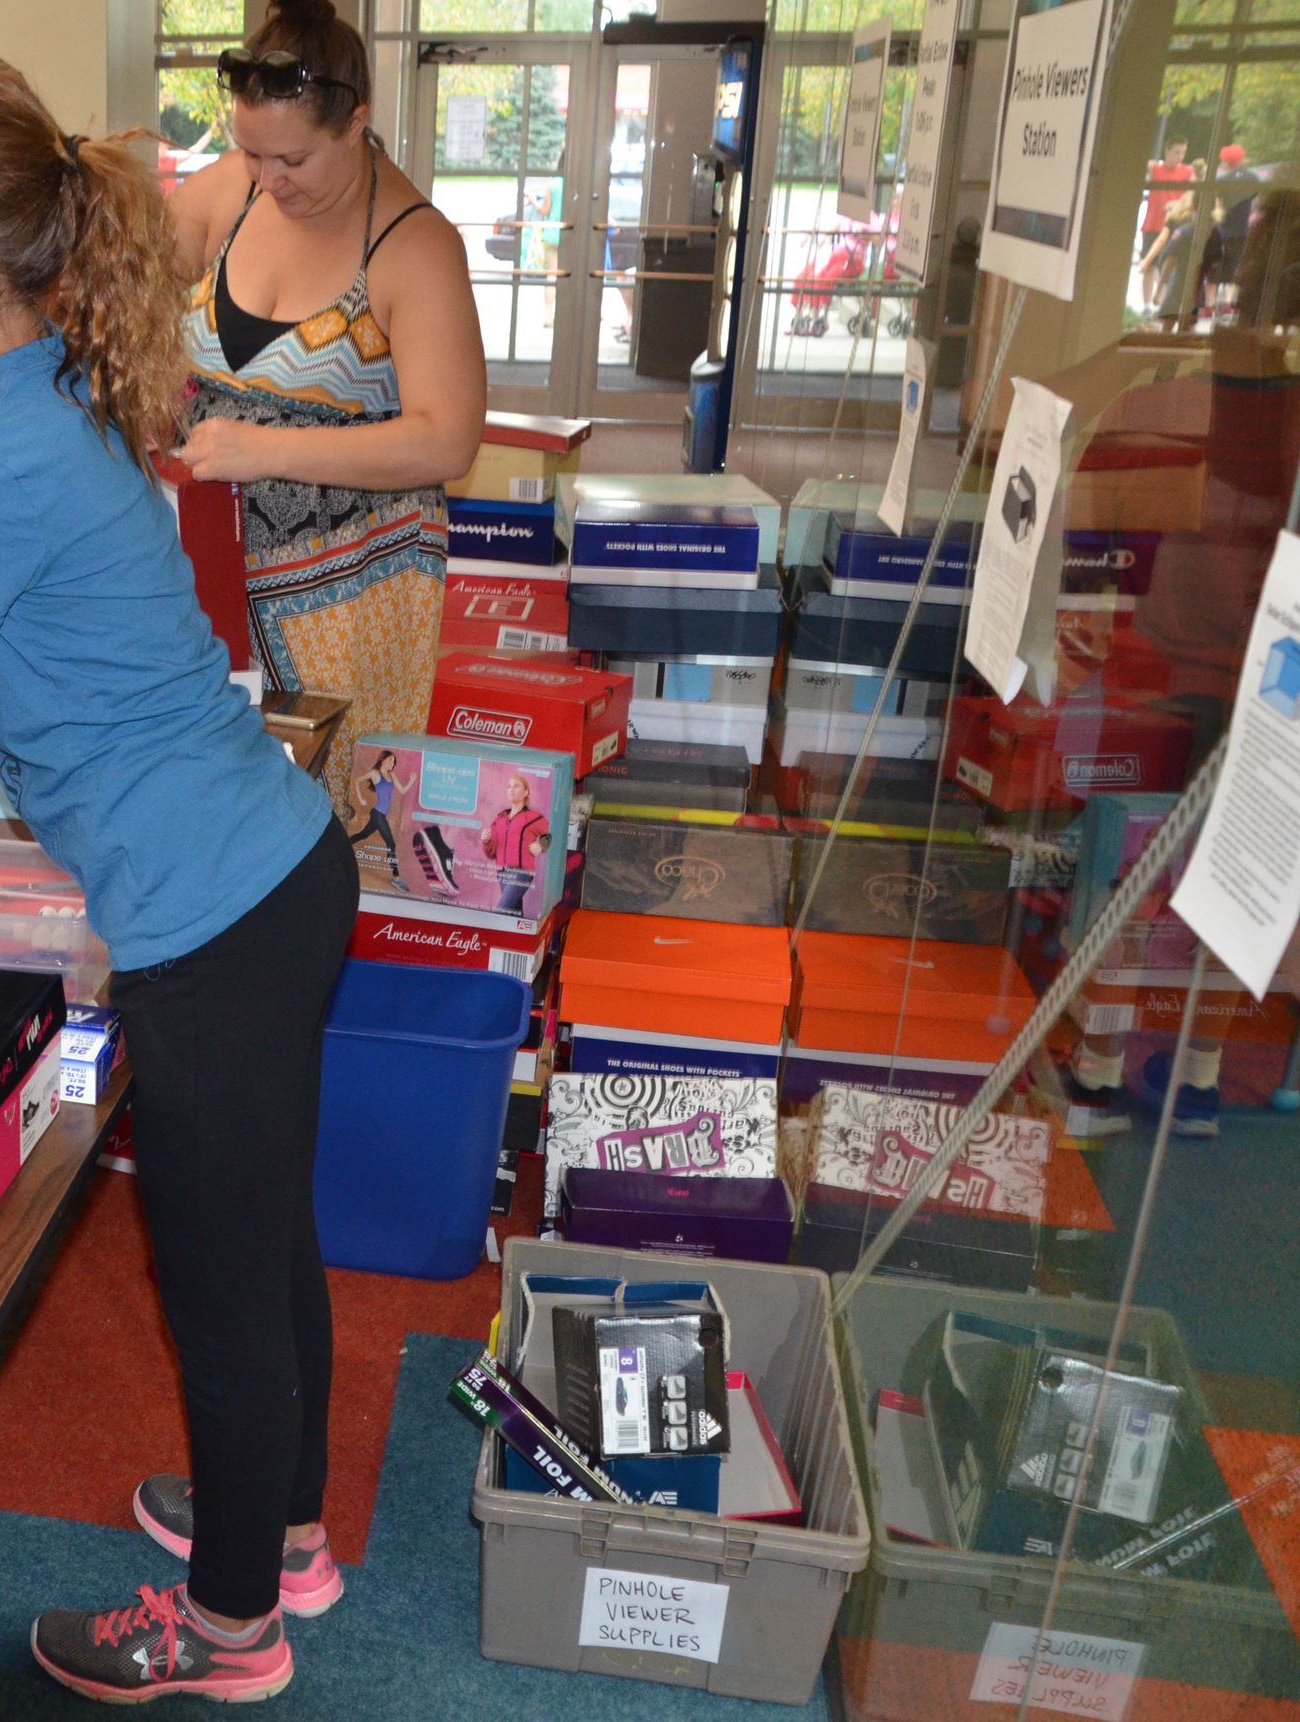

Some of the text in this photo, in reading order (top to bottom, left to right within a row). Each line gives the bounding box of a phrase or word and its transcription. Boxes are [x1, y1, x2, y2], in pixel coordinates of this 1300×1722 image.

[1012, 60, 1090, 101] Pinhole Viewers
[1021, 120, 1058, 158] Station
[447, 522, 534, 543] ampion
[636, 542, 655, 552] WITH
[713, 546, 727, 554] THE
[452, 579, 503, 596] American
[454, 710, 513, 738] Coleman
[373, 922, 482, 956] American Eagle
[68, 1045, 88, 1056] 25
[607, 1058, 741, 1078] THE ORIGINAL SHOES WITH POCKETS
[65, 1084, 85, 1098] 25
[619, 1356, 635, 1366] 8
[463, 1375, 483, 1392] SQ FT
[467, 1368, 488, 1387] 75
[456, 1381, 477, 1400] WIDE
[699, 1408, 708, 1445] adidas
[553, 1423, 590, 1467] FOIL
[532, 1445, 573, 1488] FOIL
[599, 1576, 686, 1602] PINHOLE
[606, 1602, 696, 1625] VIEWER
[598, 1624, 701, 1652] SUPPLIES
